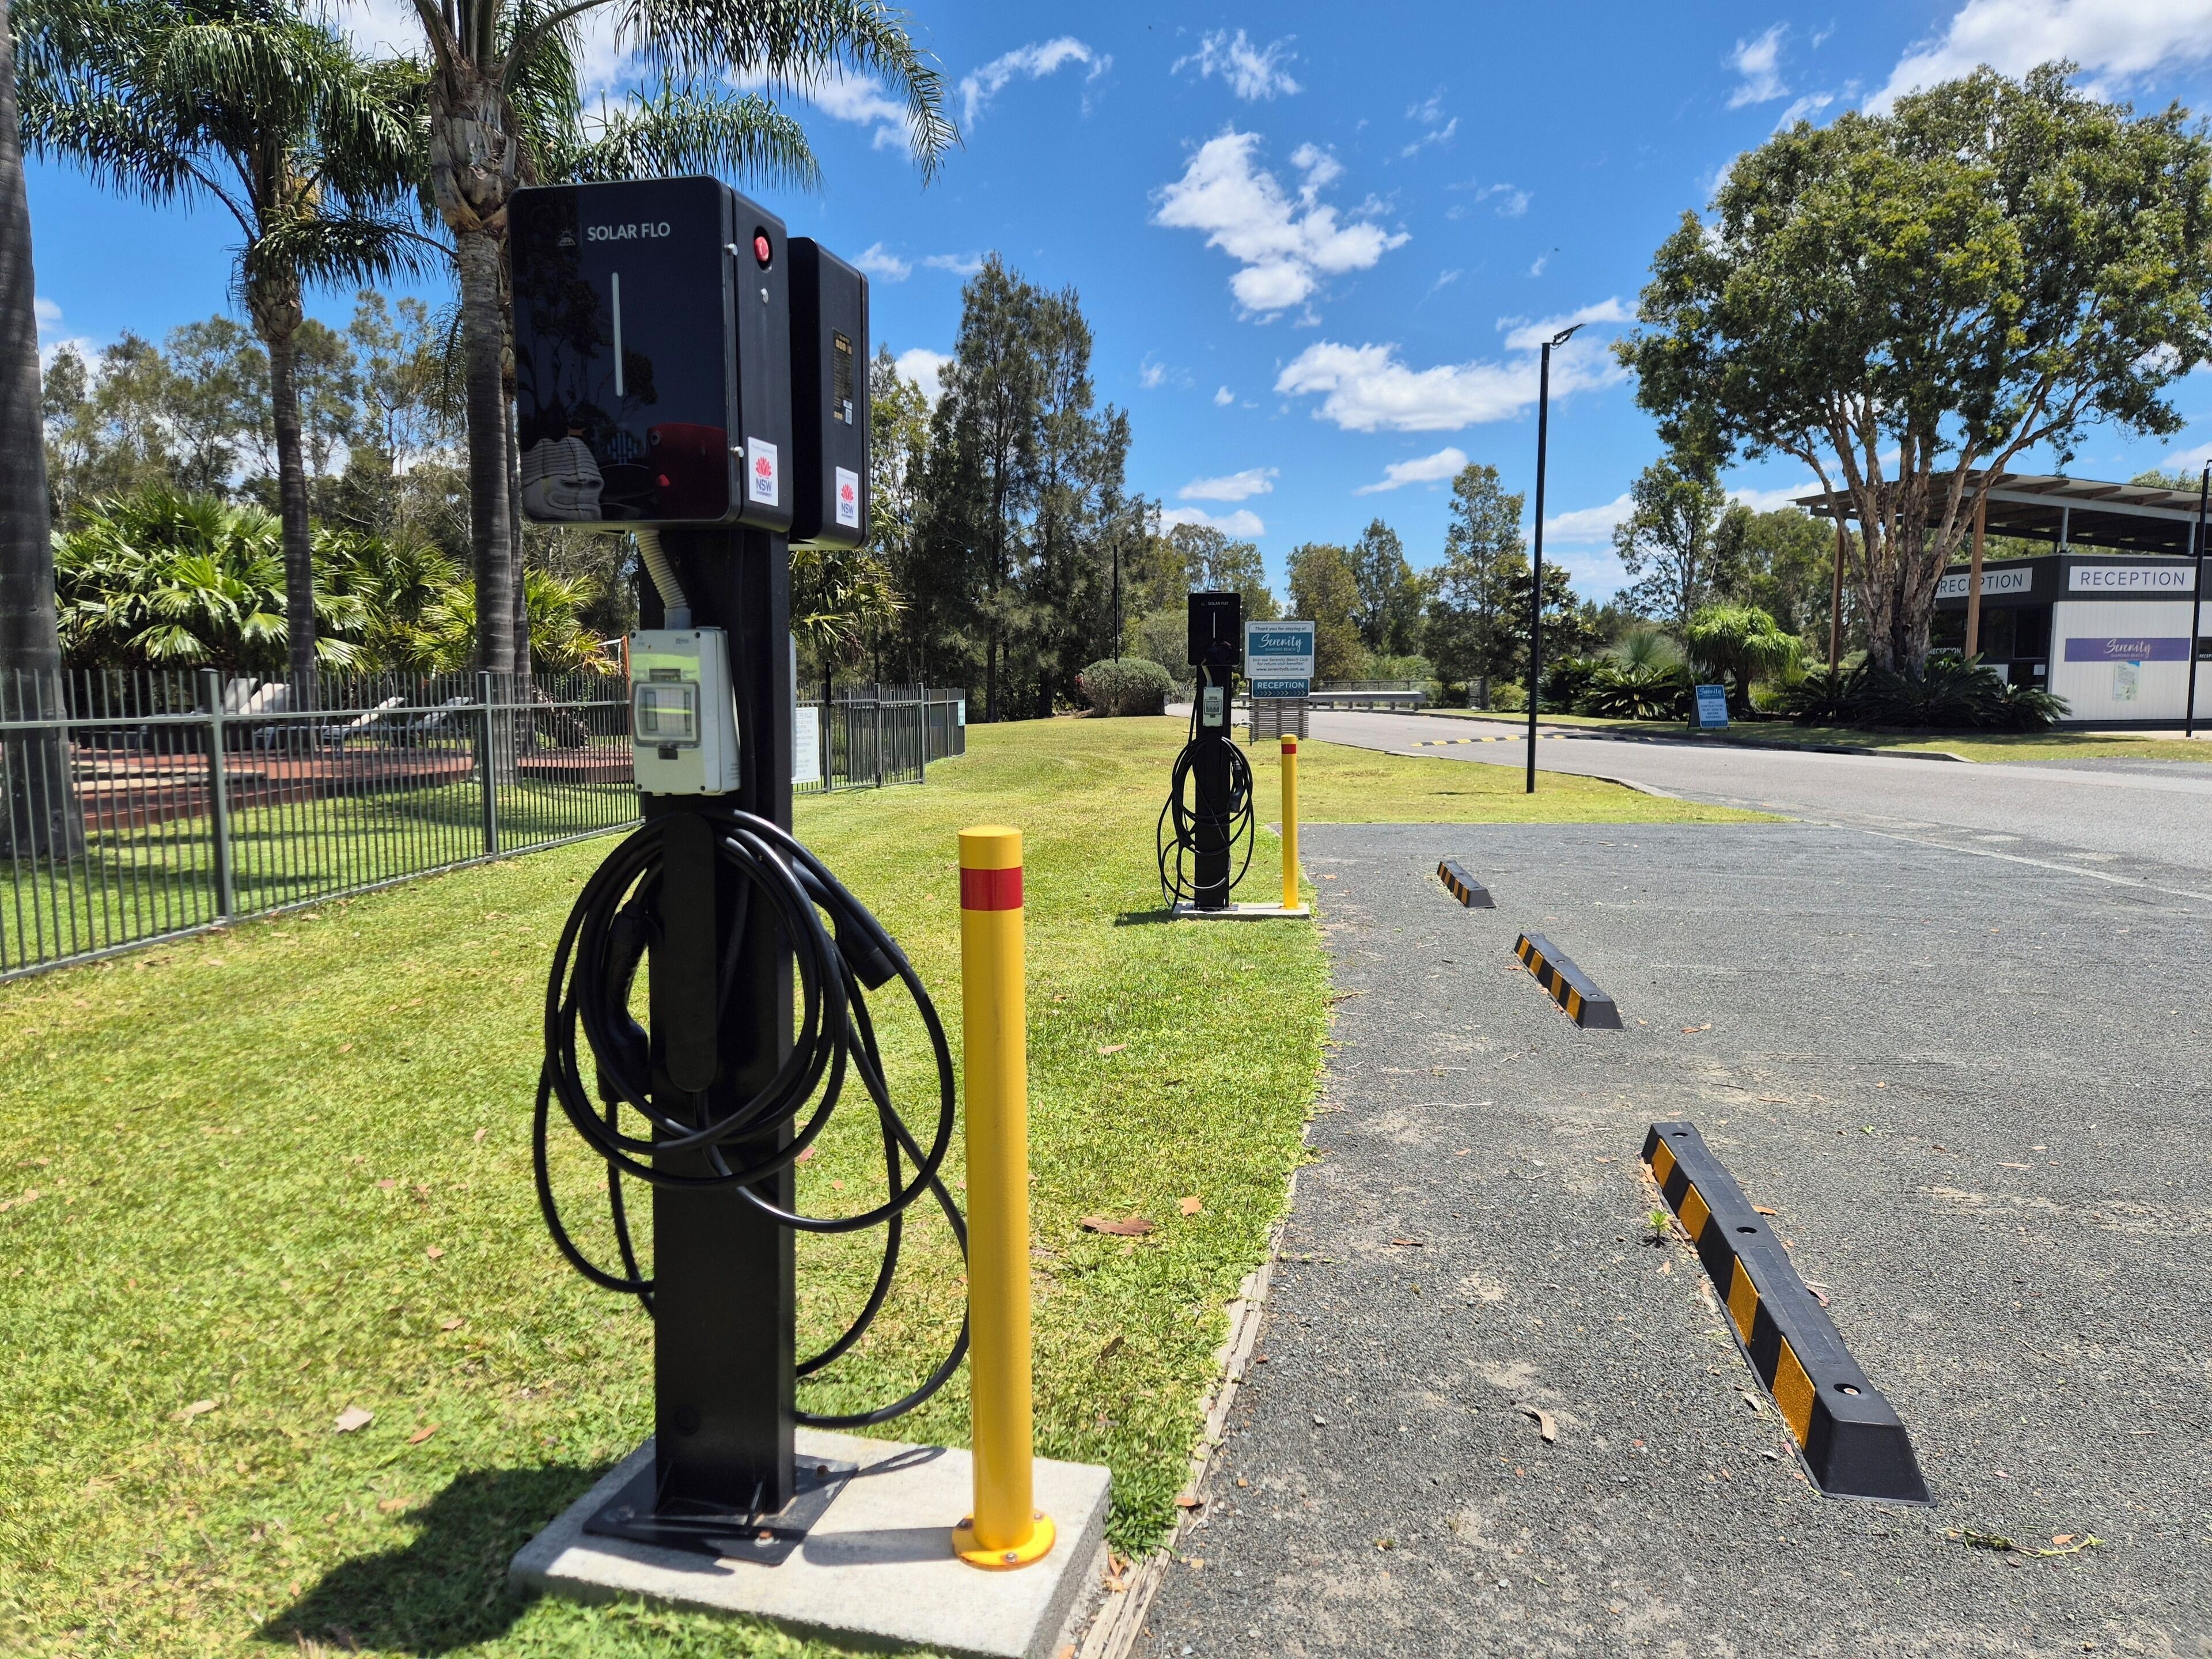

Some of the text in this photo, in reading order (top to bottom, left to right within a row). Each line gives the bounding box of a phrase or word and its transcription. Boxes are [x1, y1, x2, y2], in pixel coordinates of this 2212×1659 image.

[587, 222, 671, 241] SOLAR FLO
[756, 478, 772, 493] NSW
[842, 502, 854, 515] NSW
[2081, 571, 2185, 586] RECEPTION
[1258, 634, 1302, 652] Serenity
[2104, 638, 2152, 658] Serenity
